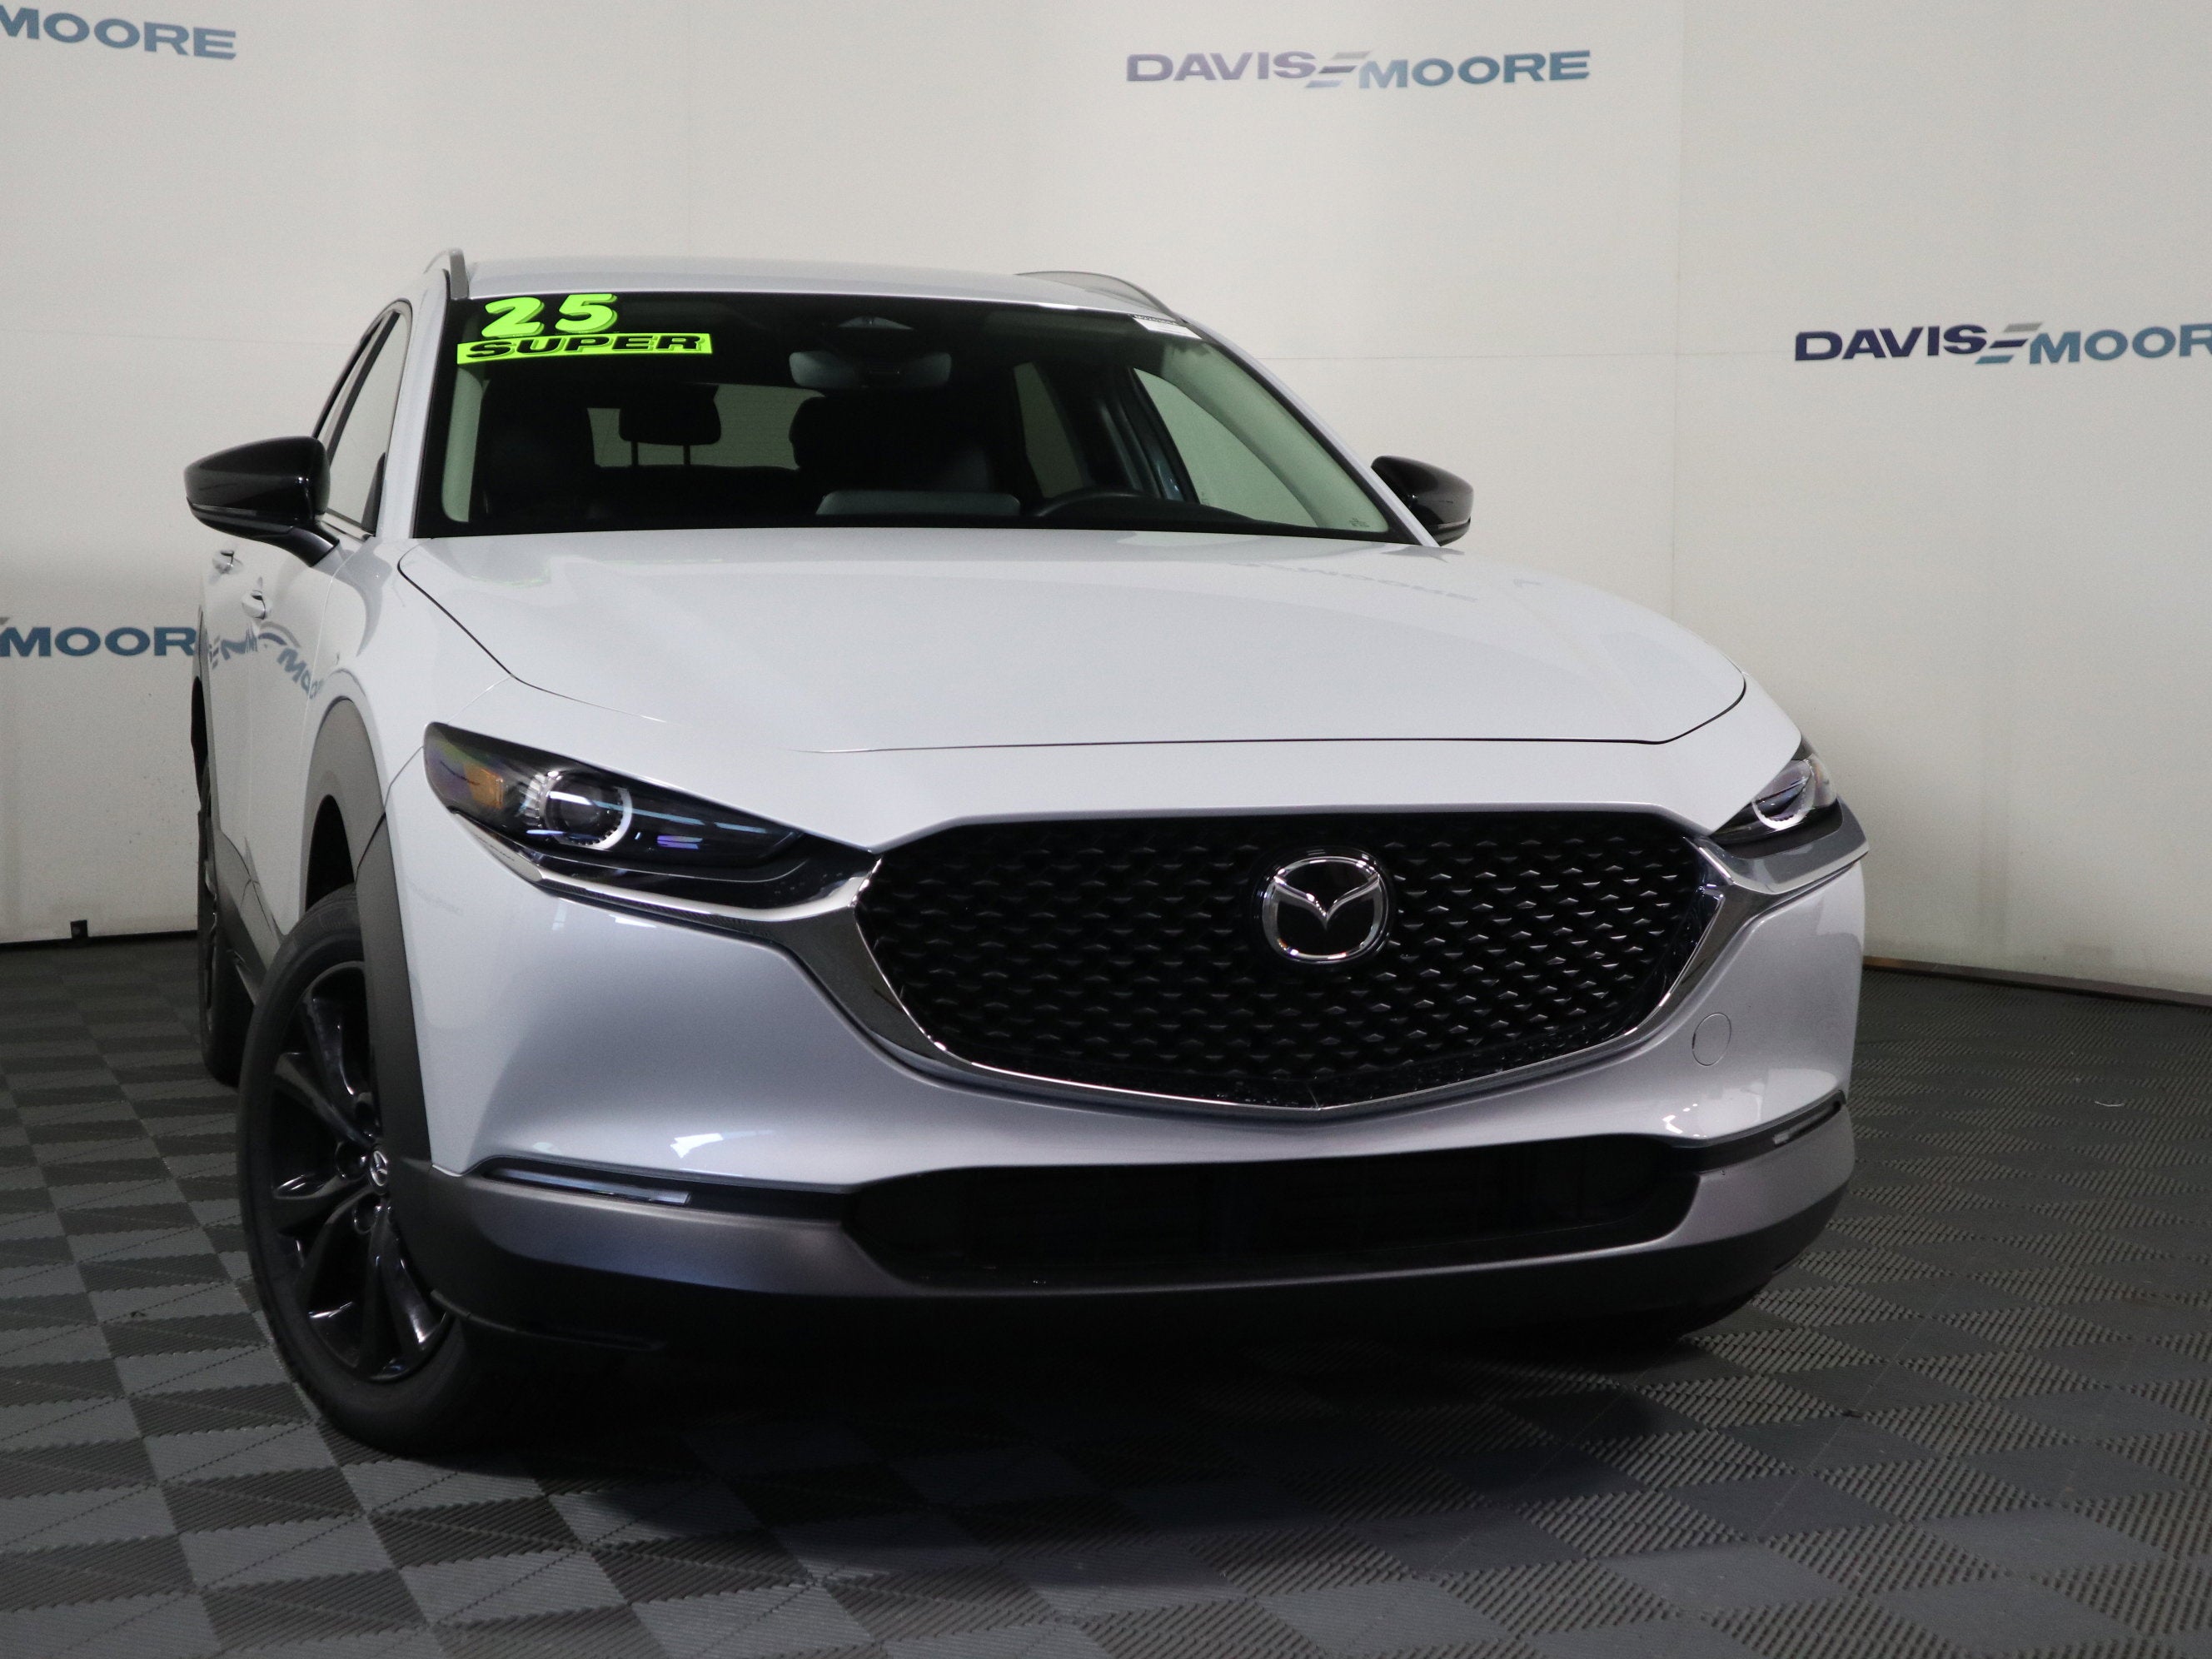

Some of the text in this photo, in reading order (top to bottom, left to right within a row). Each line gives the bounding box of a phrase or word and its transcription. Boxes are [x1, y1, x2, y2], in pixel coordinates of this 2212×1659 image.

[0, 4, 237, 60] MOORE
[1126, 50, 1590, 89] DAVIS MOORE
[481, 293, 618, 338] 25
[466, 335, 706, 359] SUPER
[1795, 324, 1988, 361] DAVIS
